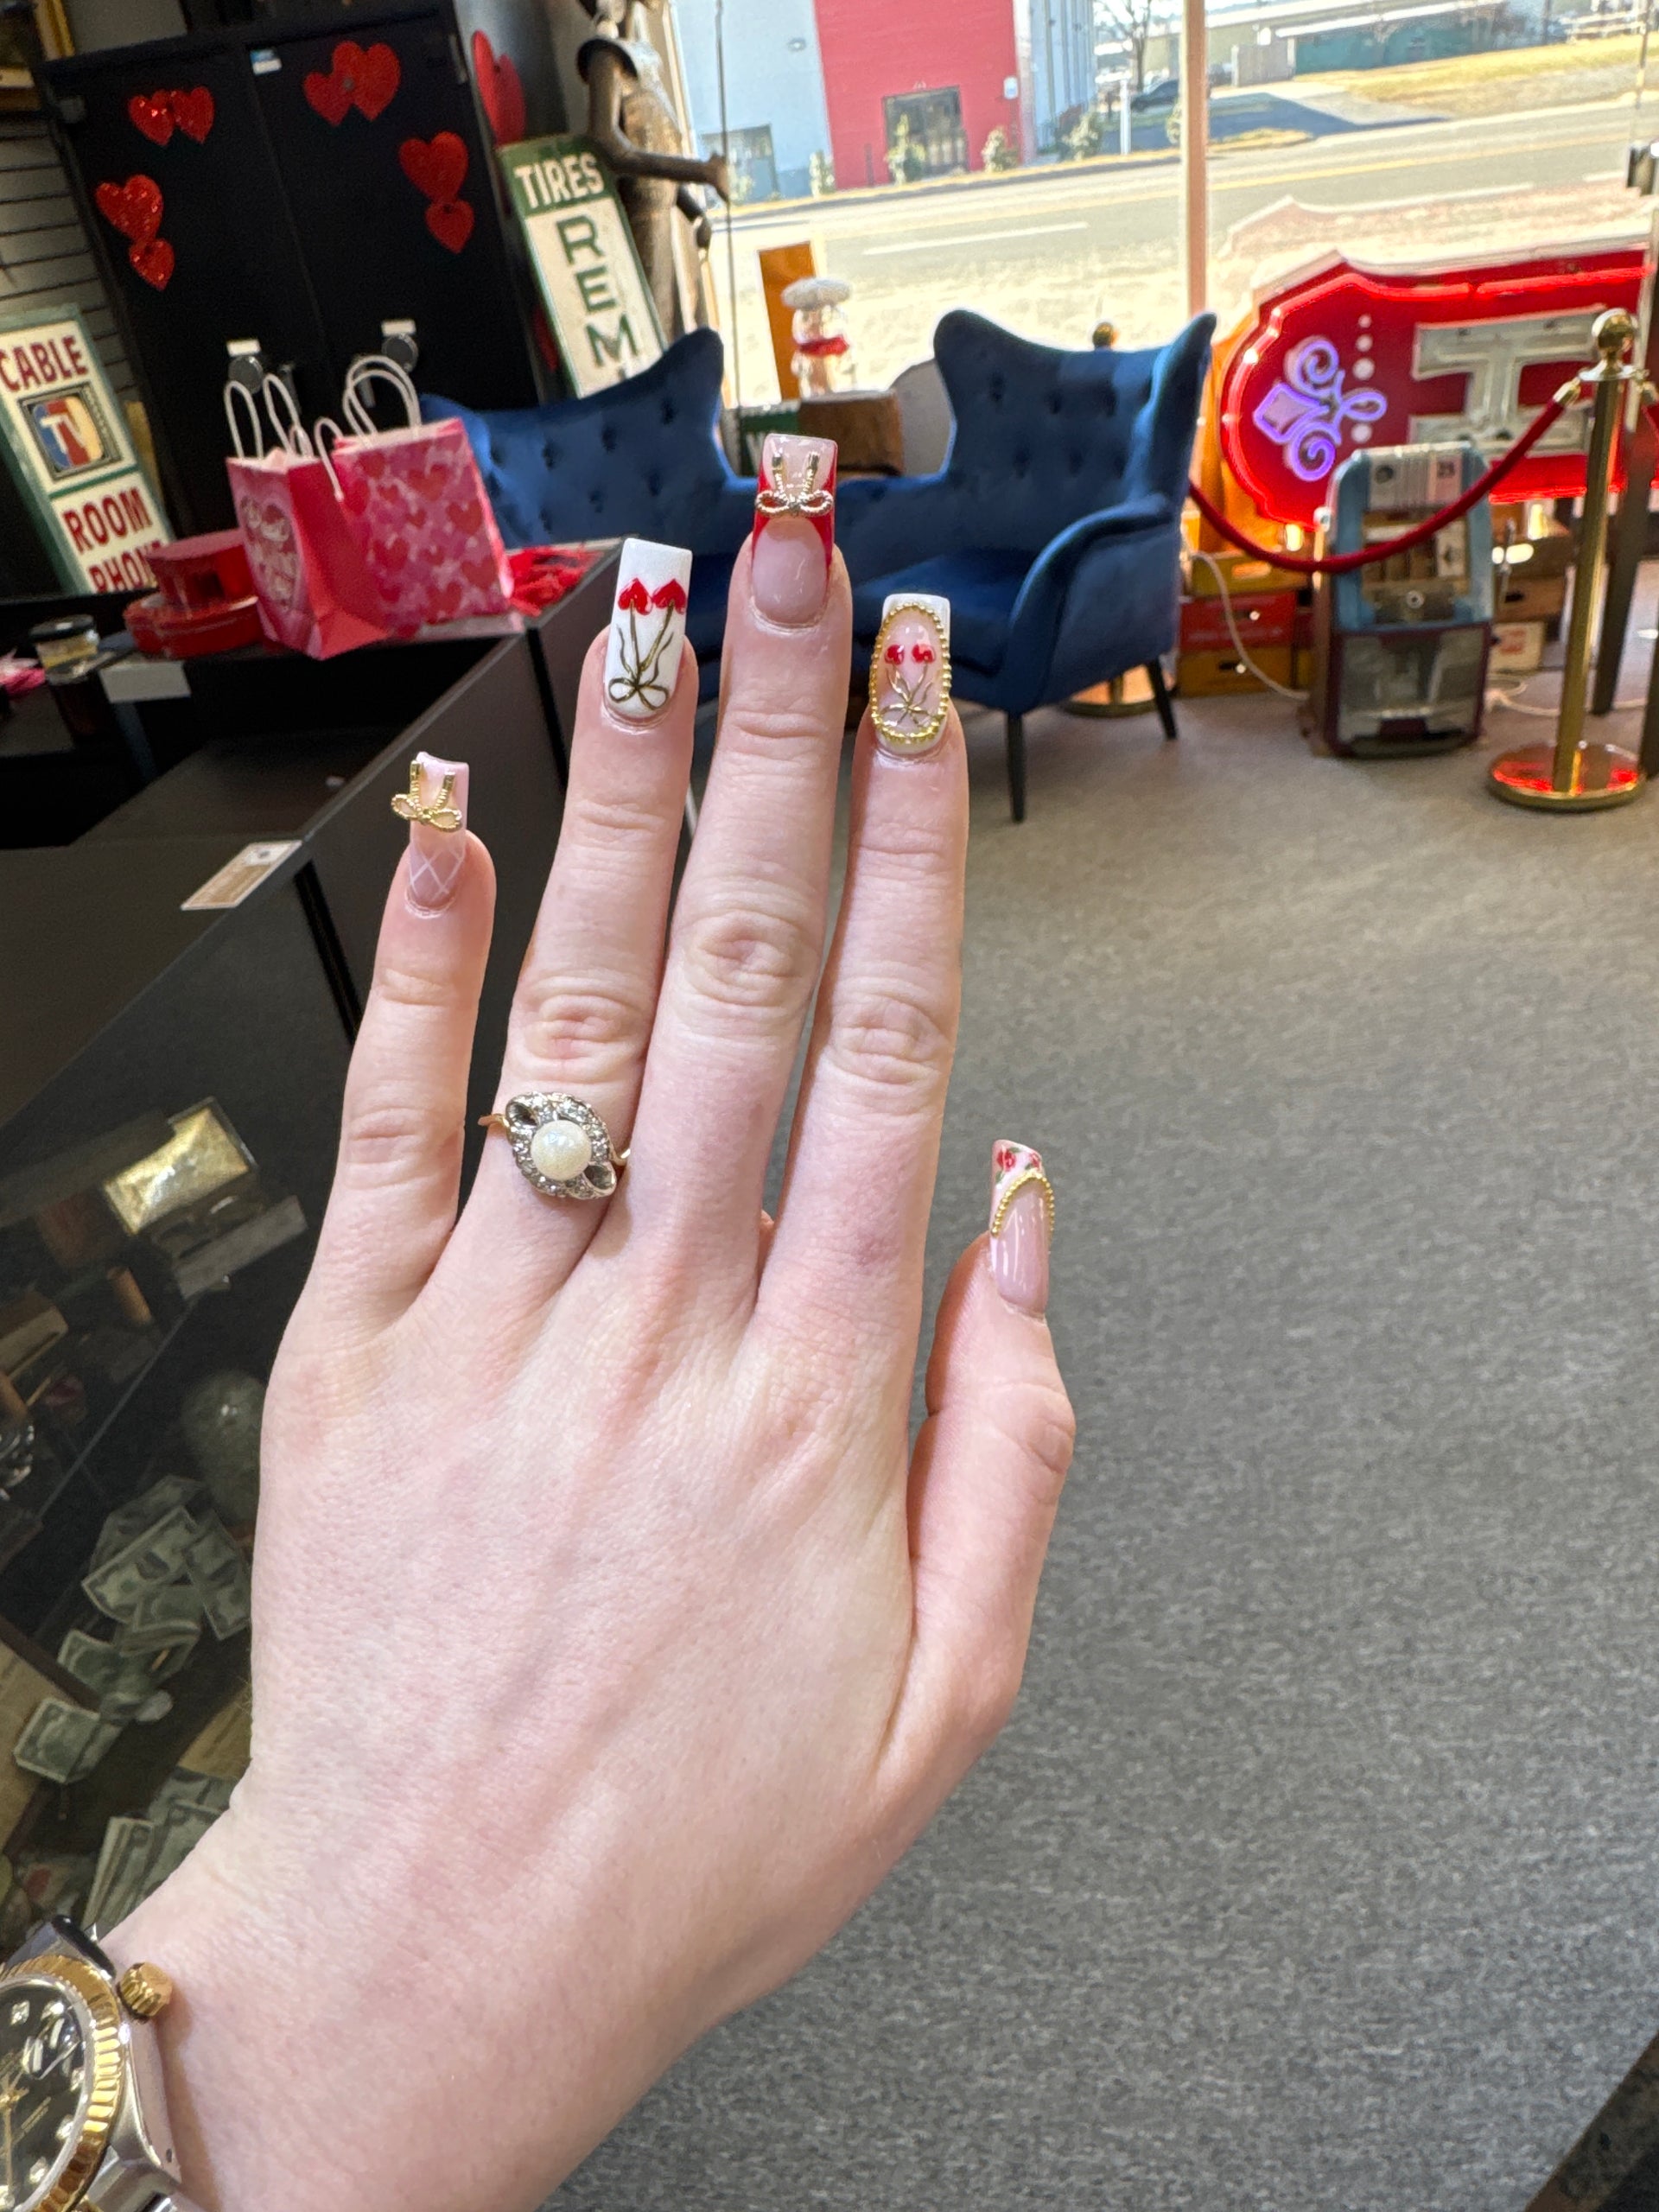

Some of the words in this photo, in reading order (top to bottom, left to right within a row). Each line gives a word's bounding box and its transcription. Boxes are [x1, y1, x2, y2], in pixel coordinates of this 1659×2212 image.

[514, 152, 604, 209] TIRES
[556, 215, 639, 378] REM
[0, 335, 89, 392] CABLE
[40, 406, 94, 455] TV
[62, 486, 154, 555] ROOM
[88, 539, 162, 594] PHO
